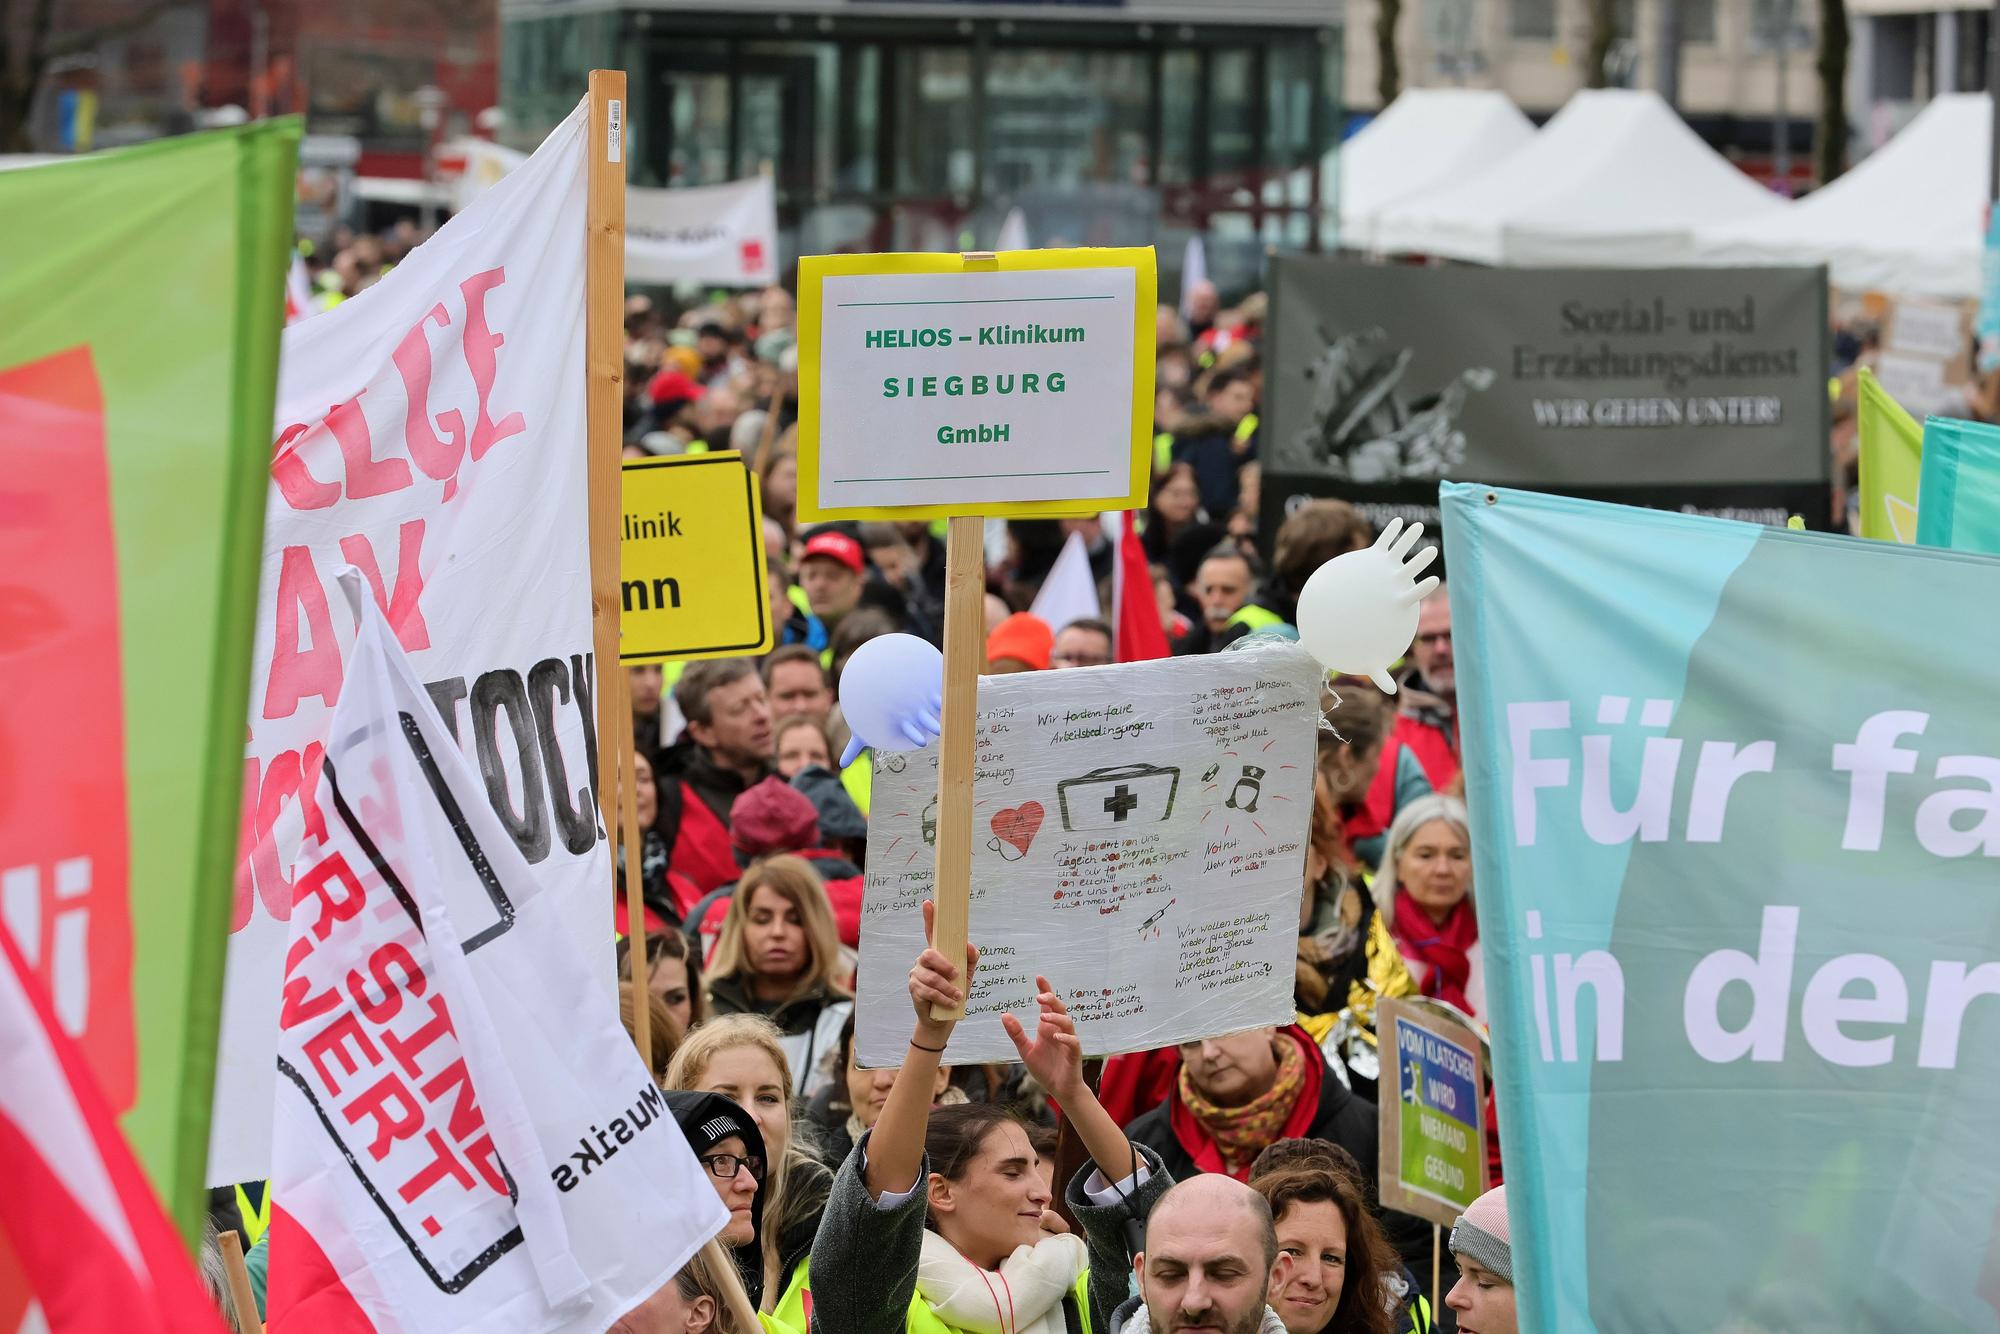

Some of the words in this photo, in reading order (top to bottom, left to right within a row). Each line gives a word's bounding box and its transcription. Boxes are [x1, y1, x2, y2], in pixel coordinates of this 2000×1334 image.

[1562, 296, 1676, 334] Sozial-
[1689, 296, 1755, 334] und
[865, 328, 953, 349] HELIOS
[978, 324, 1085, 346] Klinikum
[1512, 341, 1800, 386] Erziehungsdienst
[882, 372, 1067, 398] SIEGBURG
[1532, 399, 1588, 426] WIR
[1593, 399, 1682, 427] GEHEN
[936, 423, 1011, 445] GmbH
[624, 511, 683, 541] linik
[1037, 713, 1059, 728] Wir
[1050, 722, 1154, 746] Arbeitsbedingungen
[1508, 695, 1774, 846] Für
[1833, 710, 2000, 858] fa
[1054, 843, 1078, 859] Ihr
[1053, 890, 1083, 900] Ohne
[1177, 924, 1196, 939] Wir
[1233, 912, 1271, 926] endlich
[1526, 908, 1624, 1064] in
[1683, 905, 2000, 1068] der
[1399, 1026, 1425, 1057] VOM
[1425, 1036, 1476, 1083] KLATSCHEN
[1428, 1077, 1456, 1111] WIRD
[1420, 1113, 1467, 1154] NIEMAND
[1424, 1154, 1465, 1192] GESUND
